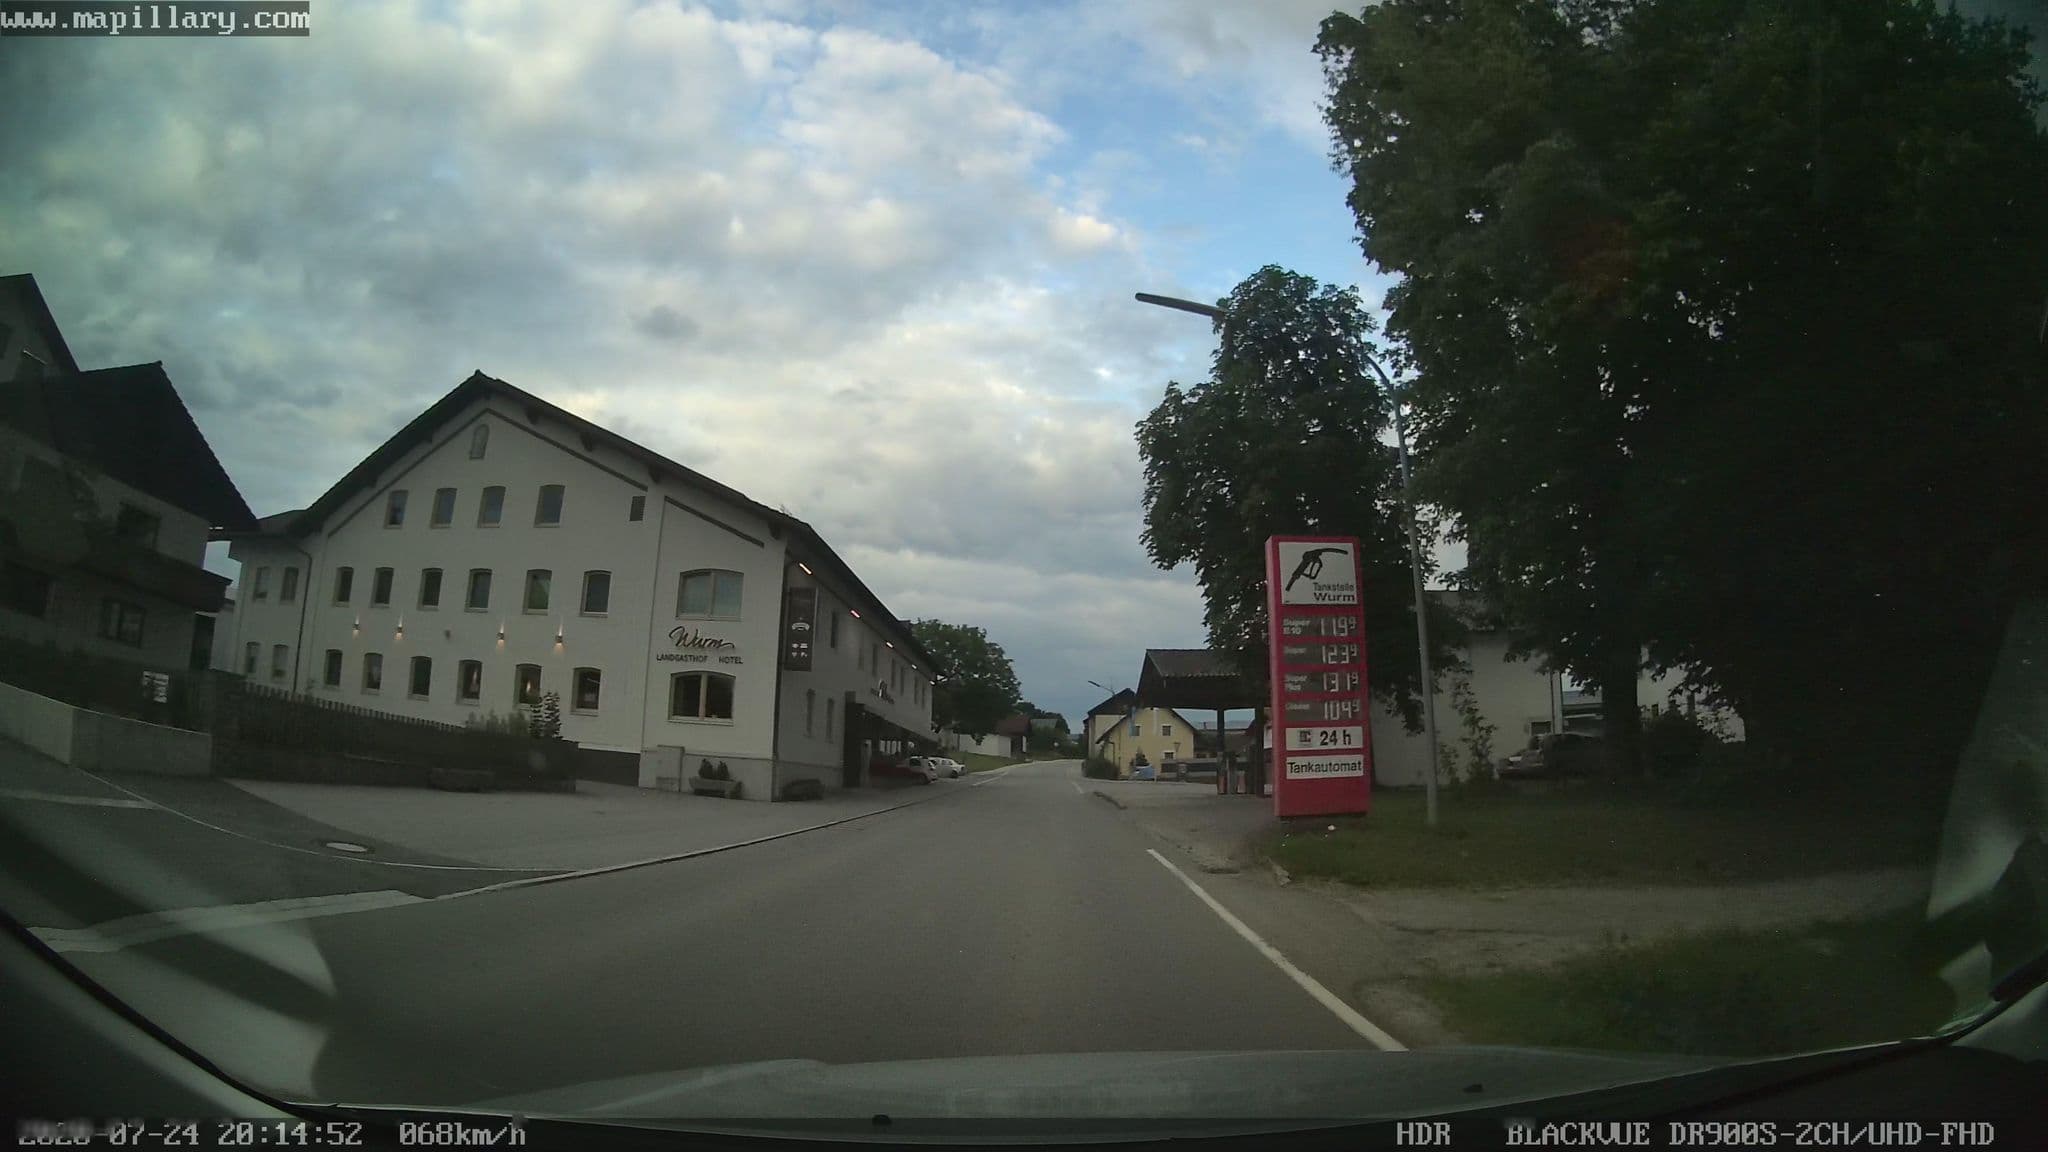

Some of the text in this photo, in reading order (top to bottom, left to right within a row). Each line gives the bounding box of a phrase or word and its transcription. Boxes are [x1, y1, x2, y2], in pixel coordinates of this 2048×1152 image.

[1313, 592, 1356, 601] Wurm
[656, 653, 744, 665] LANDGASTHOF HOTEL
[1320, 730, 1338, 746] 24
[1342, 729, 1352, 746] h
[1287, 760, 1362, 774] Tankautomat
